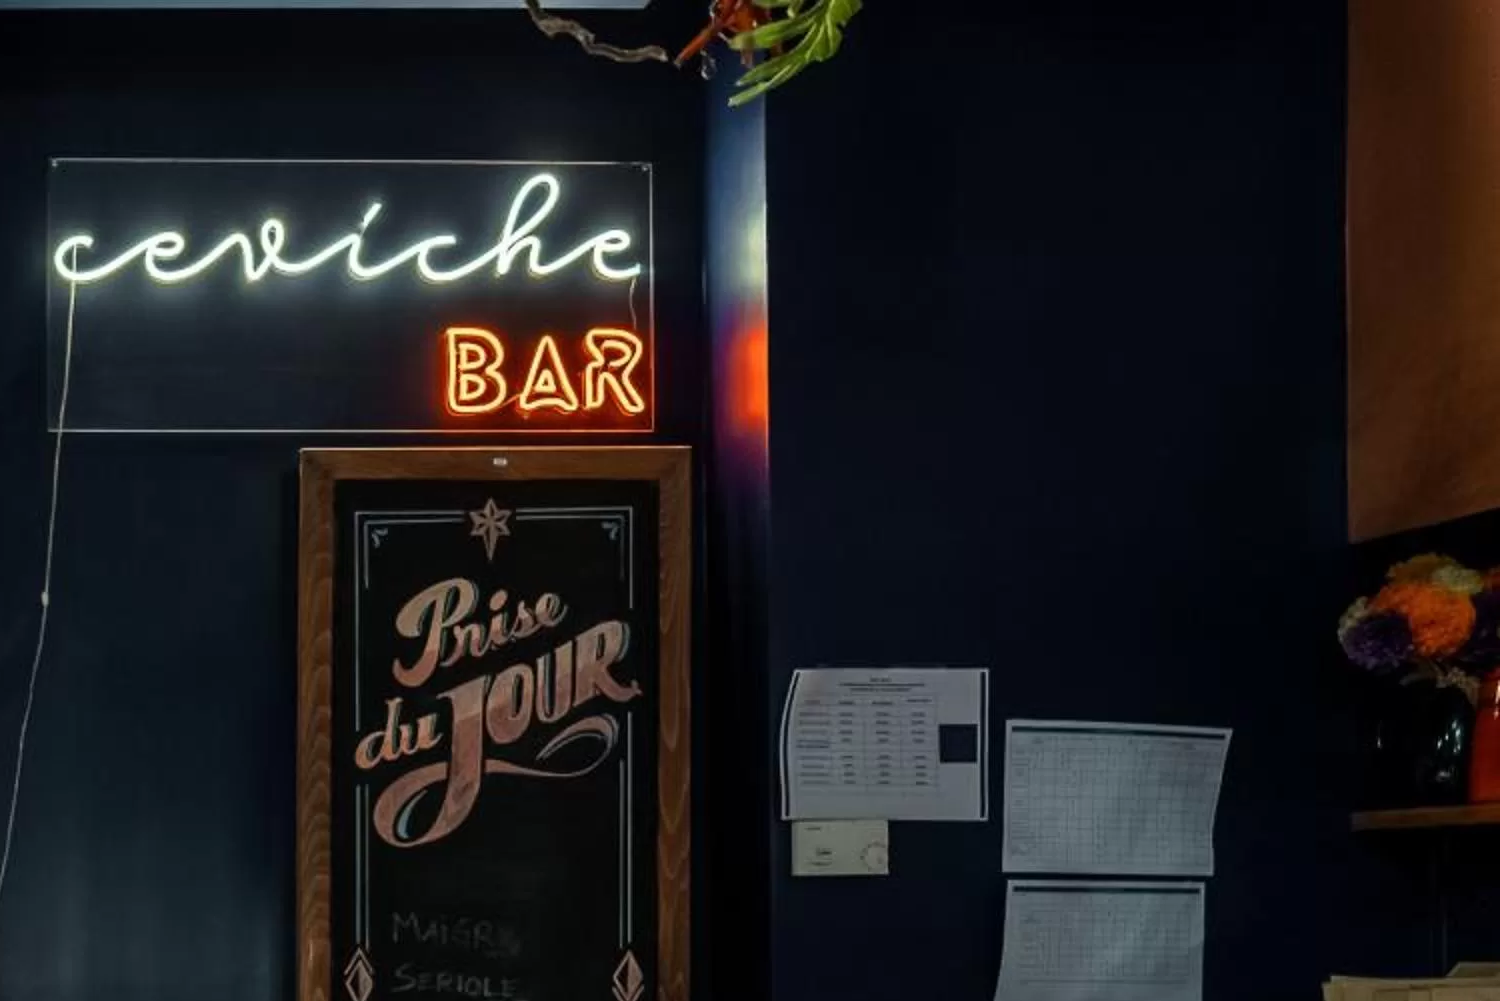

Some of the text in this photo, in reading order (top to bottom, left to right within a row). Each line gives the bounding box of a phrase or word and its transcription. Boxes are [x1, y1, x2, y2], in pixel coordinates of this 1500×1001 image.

[55, 174, 641, 280] ceviche
[446, 328, 644, 413] BAR
[394, 577, 567, 687] Prise
[355, 698, 442, 769] du
[373, 619, 641, 847] JOUR
